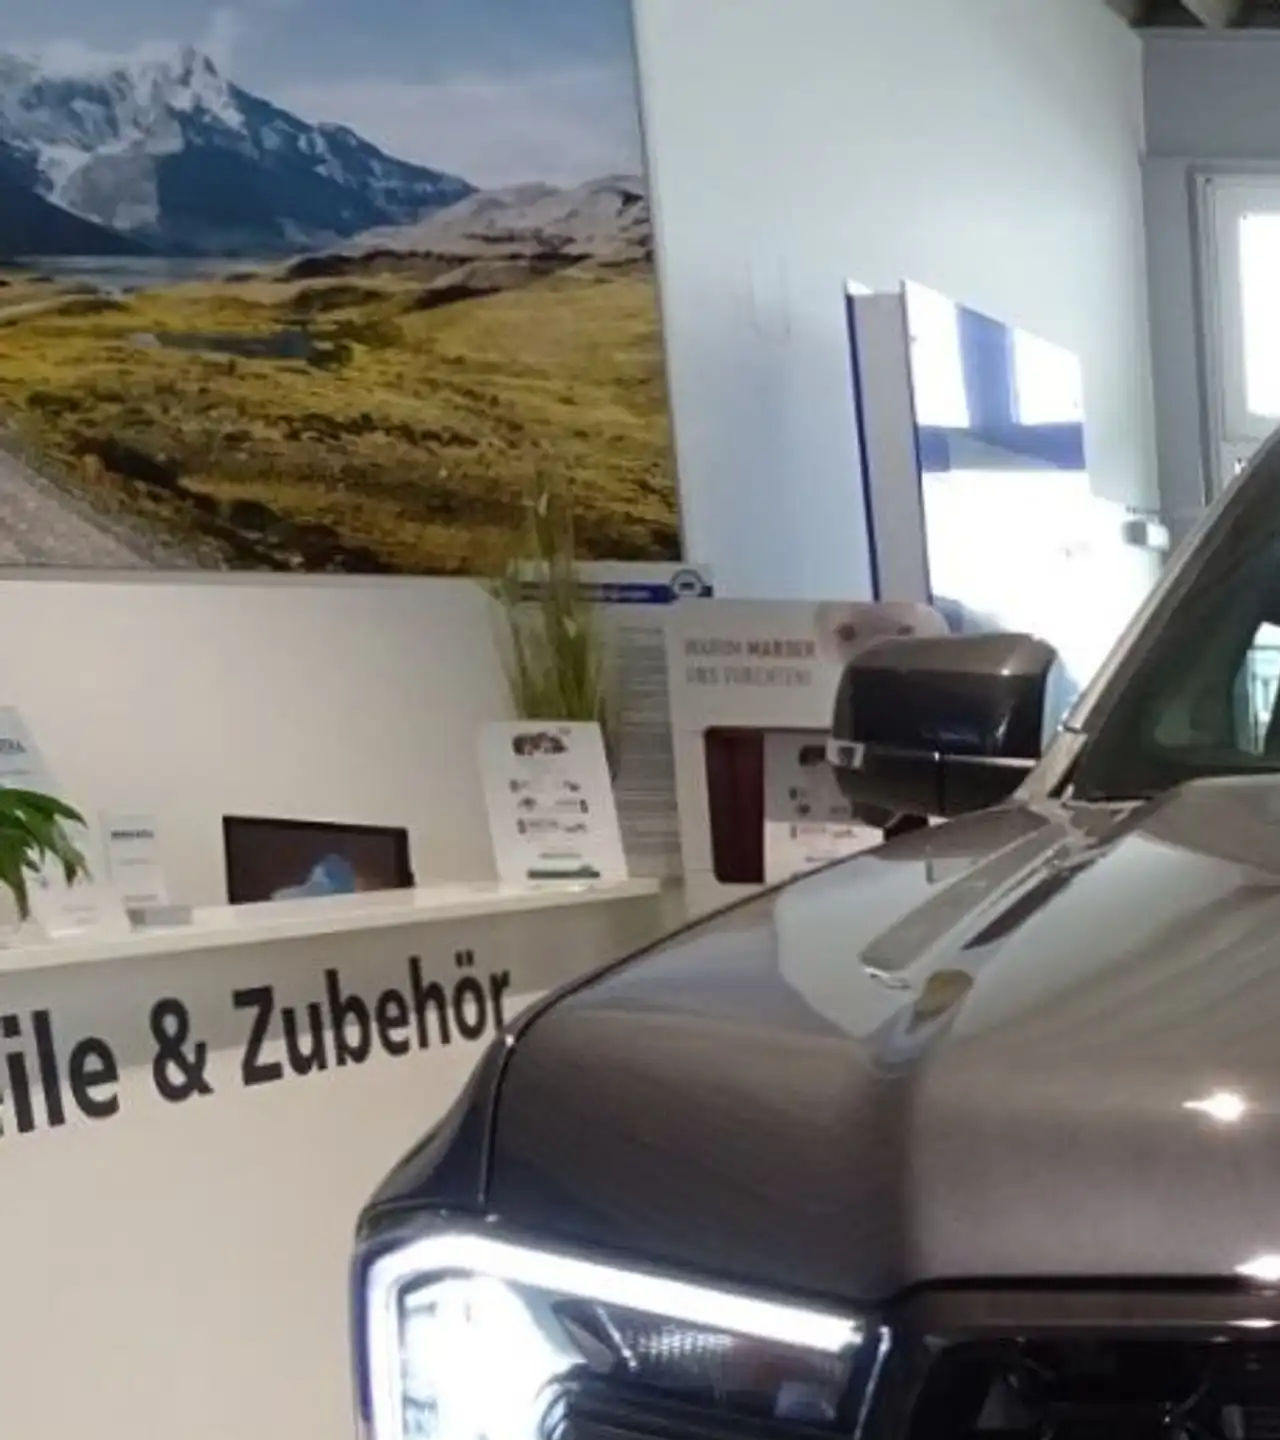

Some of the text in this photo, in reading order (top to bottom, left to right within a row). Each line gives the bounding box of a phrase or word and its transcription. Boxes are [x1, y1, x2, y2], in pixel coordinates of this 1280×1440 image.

[0, 949, 511, 1135] ile & Zubehör
